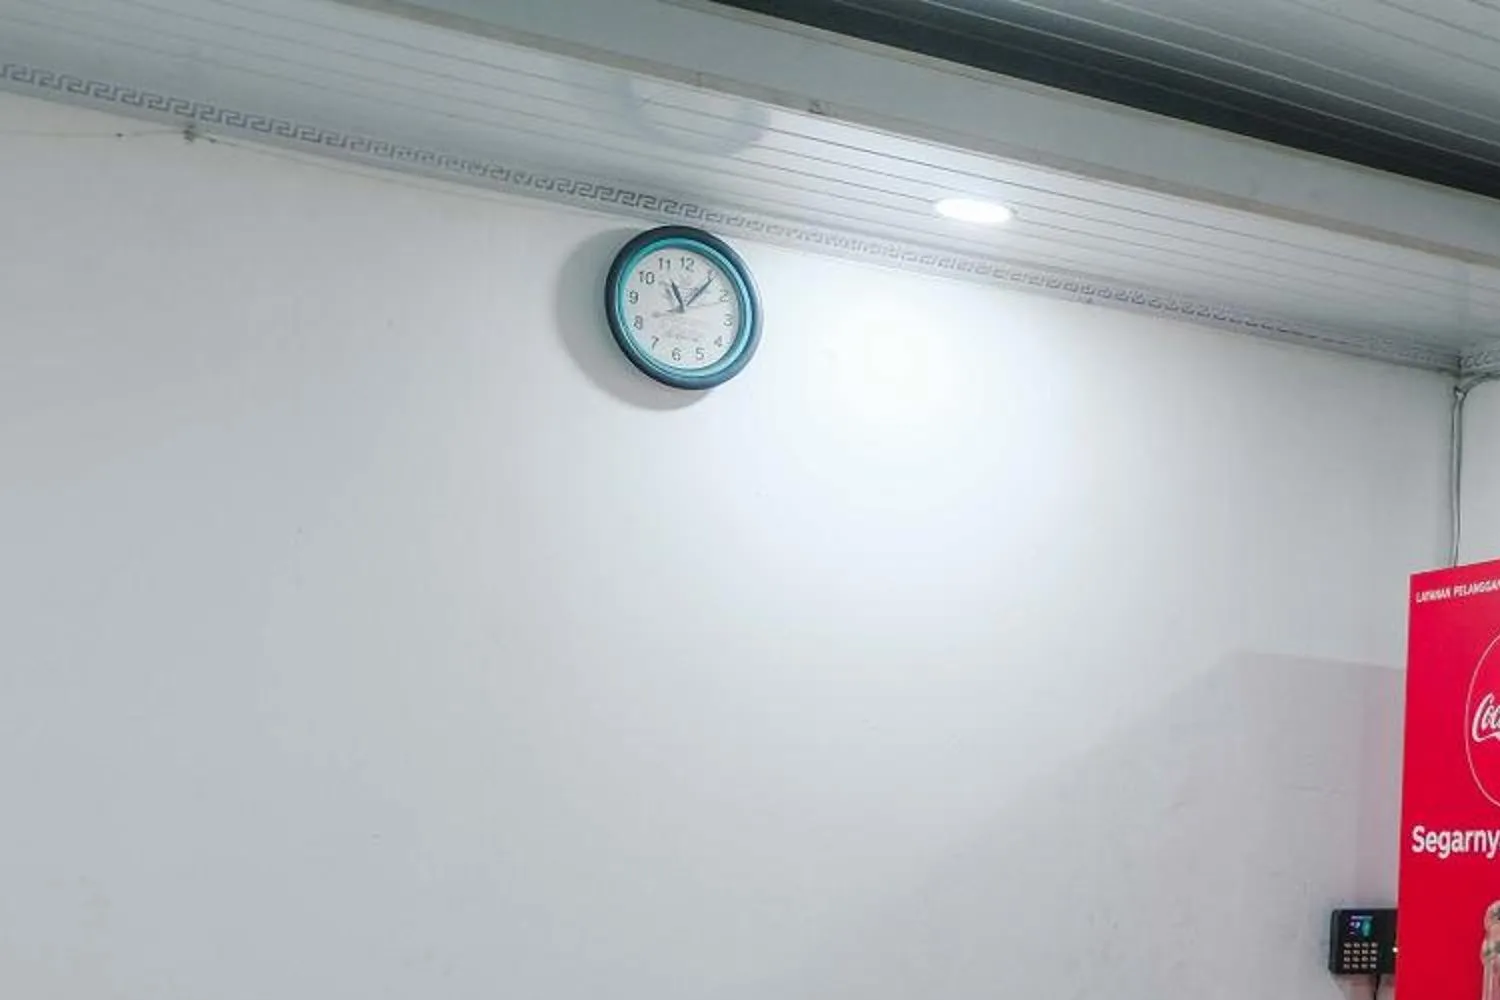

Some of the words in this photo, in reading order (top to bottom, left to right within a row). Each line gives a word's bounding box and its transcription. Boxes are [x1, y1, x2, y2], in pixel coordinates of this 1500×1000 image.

[658, 257, 671, 271] 11
[680, 257, 695, 272] 12
[639, 271, 655, 285] 10
[628, 290, 639, 304] 9
[719, 289, 729, 302] 2
[633, 315, 643, 330] 8
[723, 313, 733, 327] 3
[651, 335, 660, 349] 7
[714, 335, 723, 348] 4
[671, 348, 681, 362] 6
[695, 347, 705, 361] 5
